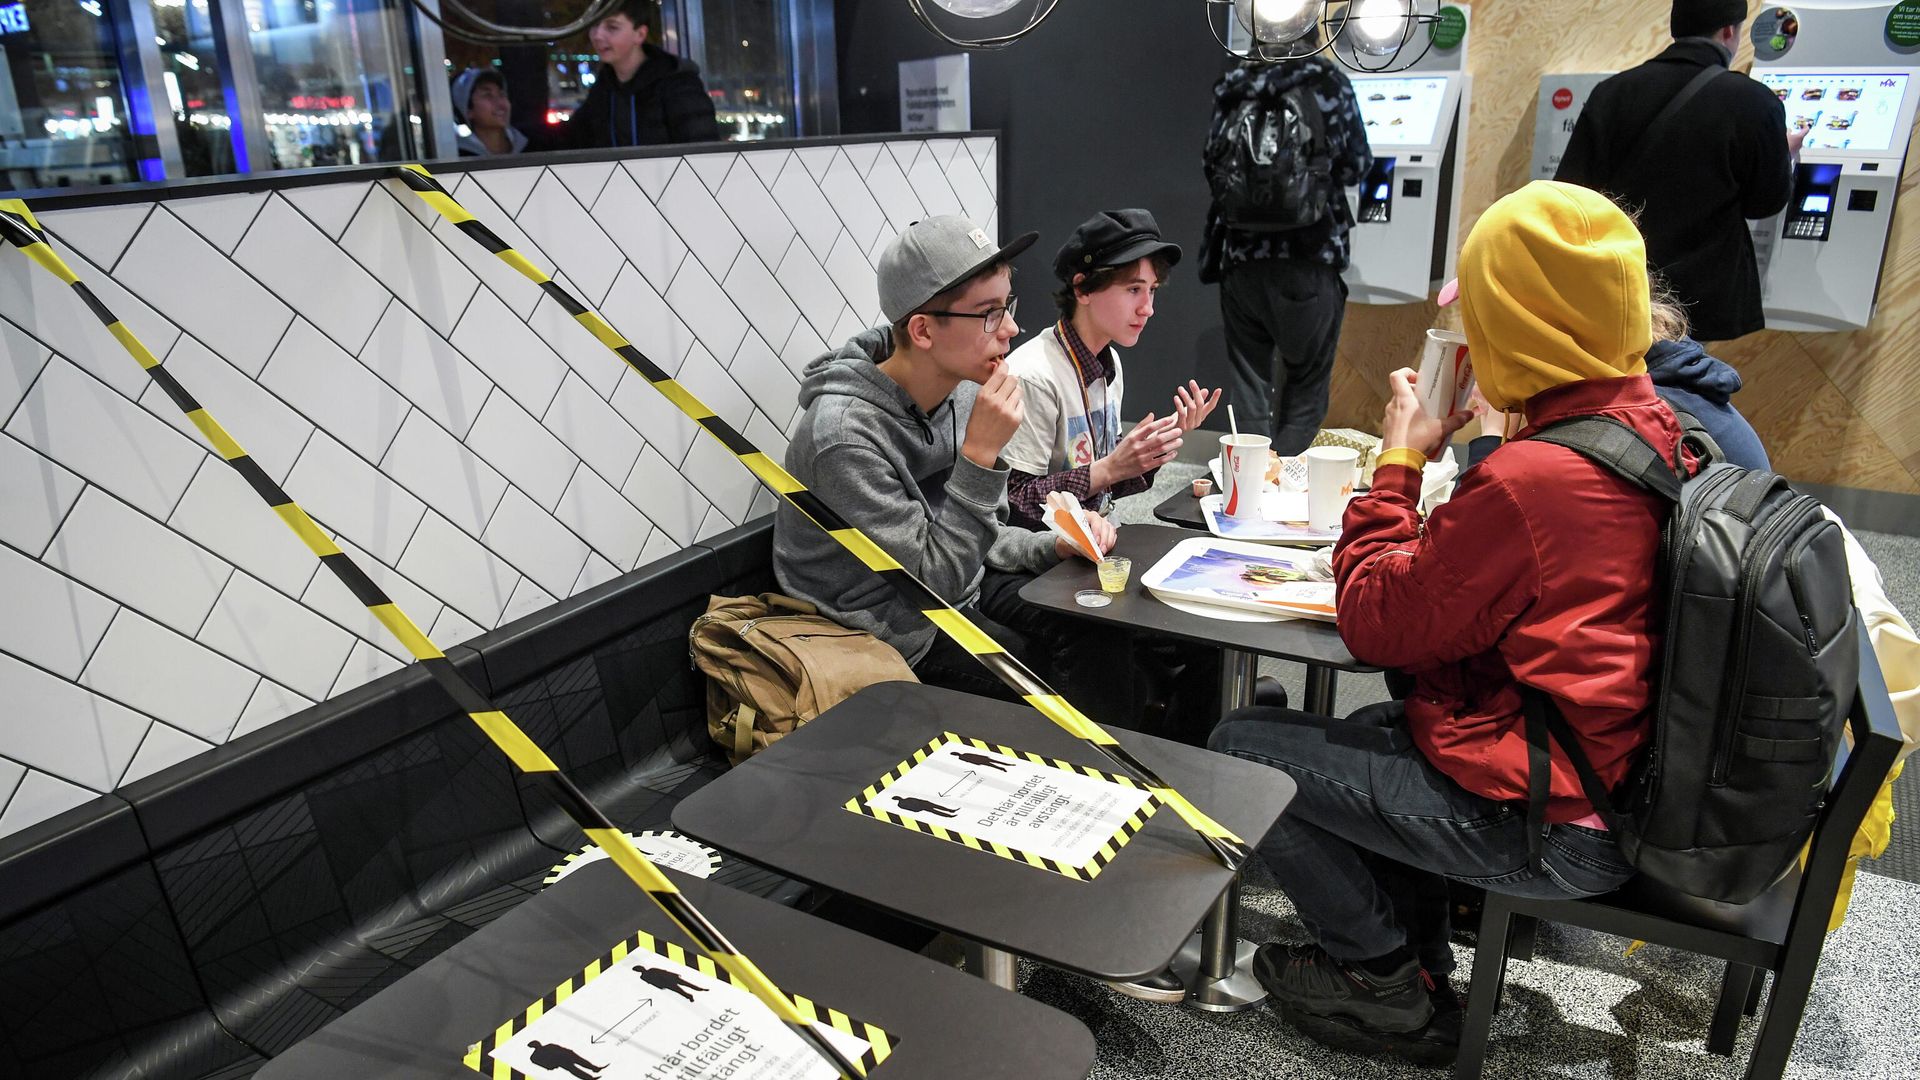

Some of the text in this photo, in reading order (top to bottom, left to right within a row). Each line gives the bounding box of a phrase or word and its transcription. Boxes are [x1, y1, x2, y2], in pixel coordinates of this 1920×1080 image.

[977, 774, 1046, 827] Det här bordet
[1002, 815, 1021, 827] är
[1013, 784, 1059, 817] tillfälligt
[1028, 794, 1073, 829] avstängt.
[652, 1007, 741, 1074] här bordet
[676, 1025, 750, 1080] tillfälligt
[710, 1043, 764, 1080] tängt.
